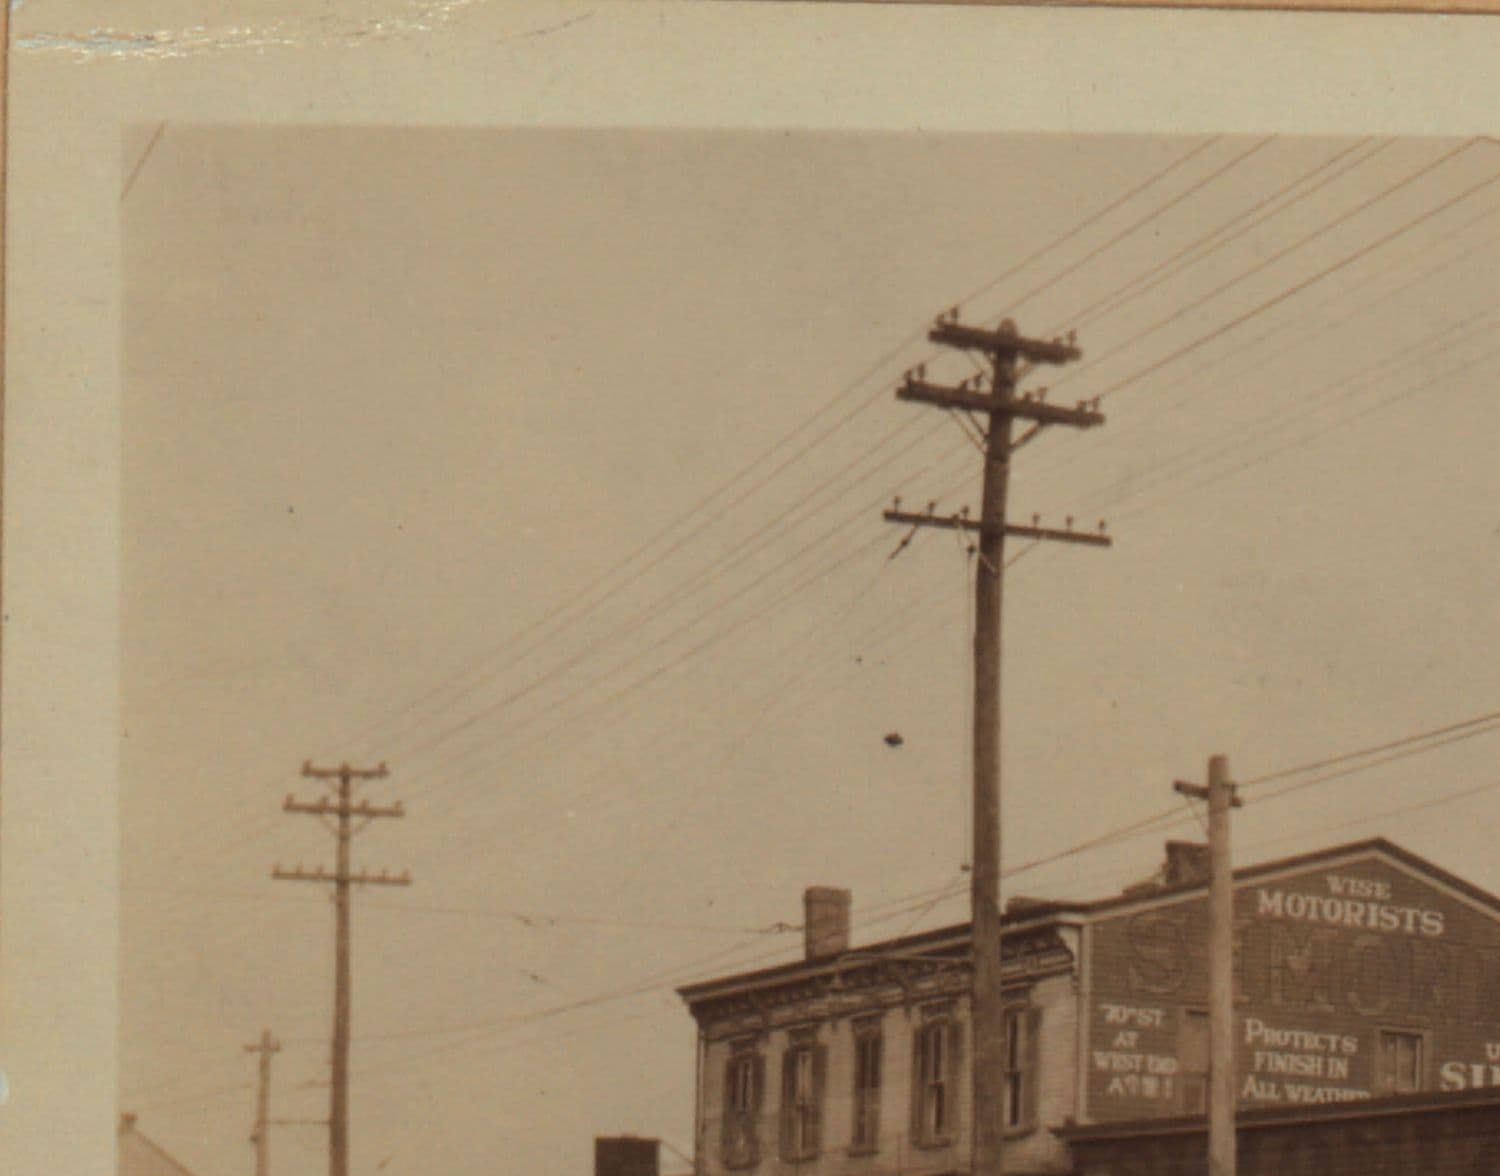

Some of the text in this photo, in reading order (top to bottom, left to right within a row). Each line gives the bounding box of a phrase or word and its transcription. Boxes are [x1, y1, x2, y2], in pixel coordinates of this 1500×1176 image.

[1326, 875, 1392, 899] WISE
[1258, 889, 1445, 936] MOTORISTS
[1245, 1018, 1359, 1055] PROTECTS
[1255, 1051, 1348, 1080] FINISH IN
[1241, 1072, 1280, 1100] ALL
